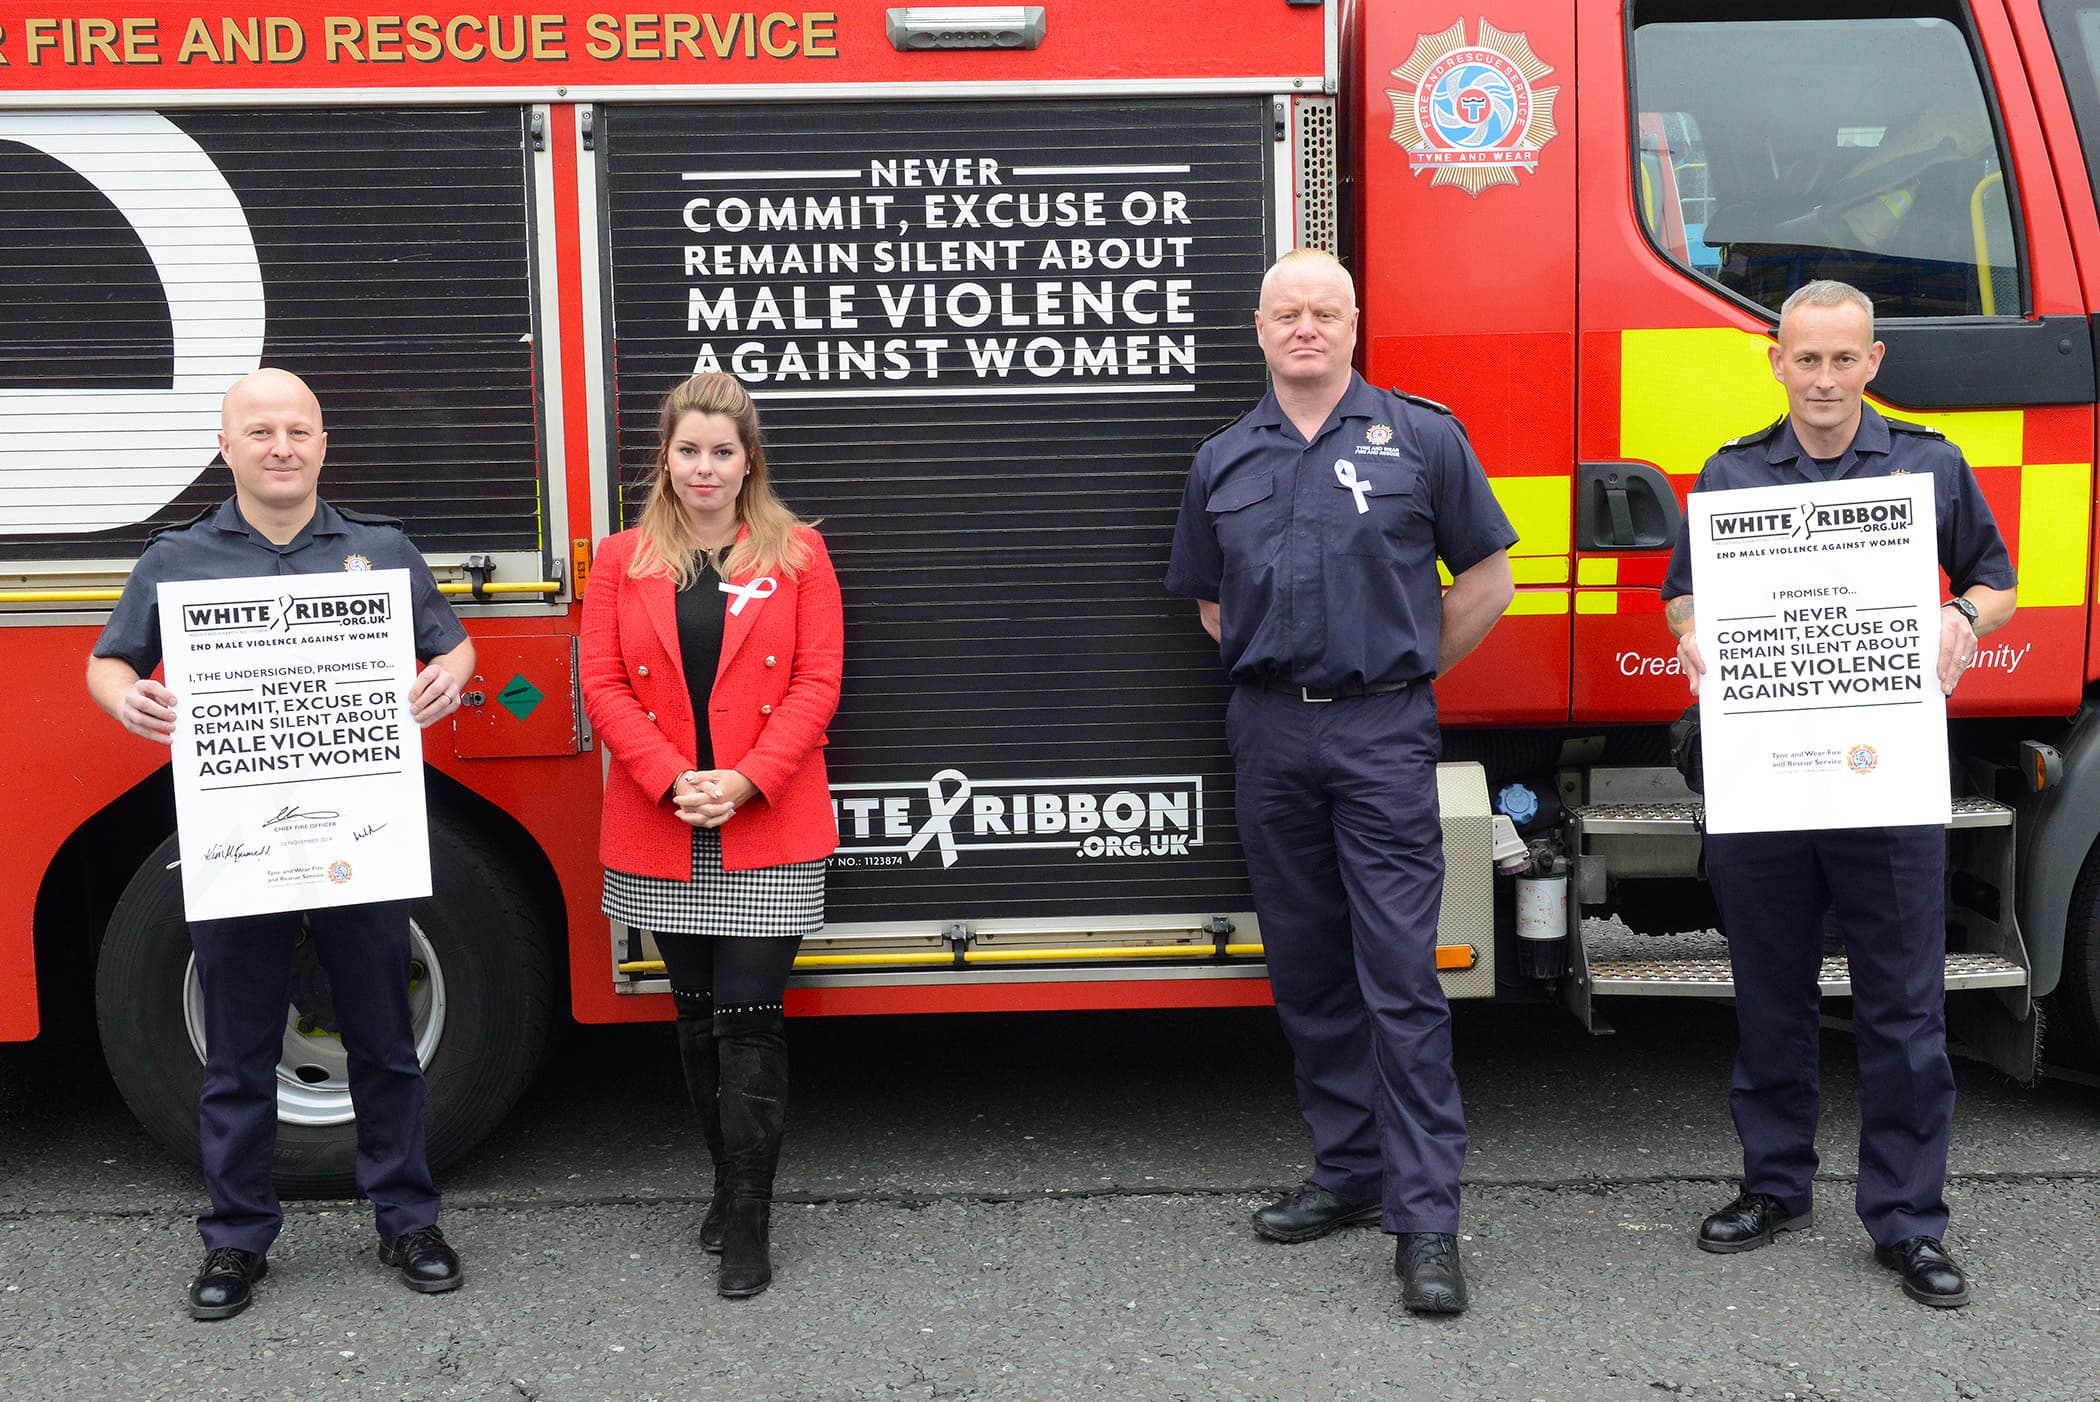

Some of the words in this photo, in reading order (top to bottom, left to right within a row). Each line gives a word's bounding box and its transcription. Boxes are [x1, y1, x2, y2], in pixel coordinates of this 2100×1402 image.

[25, 18, 161, 66] FIRE
[177, 17, 304, 63] AND
[324, 15, 567, 63] RESCUE
[585, 12, 839, 60] SERVICE
[1420, 95, 1431, 129] FIRE
[1426, 66, 1445, 93] AND
[1446, 52, 1503, 69] RESCUE
[1504, 66, 1528, 126] SERVICE
[1417, 153, 1452, 162] TYNE
[1459, 152, 1487, 161] AND
[1493, 151, 1532, 161] WEAR
[870, 158, 1002, 187] NEVER
[682, 194, 908, 236] COMMIT,
[925, 190, 1106, 229] EXCUSE
[1121, 189, 1192, 225] OR
[684, 242, 858, 276] REMAIN
[873, 239, 1024, 273] SILENT
[1038, 236, 1192, 270] ABOUT
[687, 285, 858, 332] MALE
[876, 278, 1195, 328] VIOLENCE
[693, 338, 949, 383] AGAINST
[965, 334, 1196, 378] WOMEN
[1716, 513, 1793, 535] WHITE
[1817, 503, 1907, 527] RIBBON
[1860, 521, 1907, 533] .ORG.UK
[1717, 551, 1736, 560] END
[1739, 549, 1765, 558] MALE
[1769, 545, 1818, 555] VIOLENCE
[1821, 541, 1866, 551] AGAINST
[1869, 537, 1910, 547] WOMEN
[1773, 591, 1776, 600] I
[1779, 587, 1830, 599] PROMISE
[1831, 586, 1857, 595] TO...
[189, 605, 270, 627] WHITE
[296, 598, 386, 621] RIBBON
[340, 615, 386, 627] .ORG.UK
[1783, 606, 1848, 623] NEVER
[190, 643, 211, 651] END
[215, 641, 243, 650] MALE
[246, 637, 297, 648] VIOLENCE
[301, 634, 345, 644] AGAINST
[348, 631, 388, 641] WOMEN
[1717, 626, 1800, 645] COMMIT,
[1804, 620, 1883, 639] EXCUSE
[1889, 618, 1918, 633] OR
[1719, 645, 1785, 660] REMAIN
[1790, 640, 1852, 656] SILENT
[1855, 635, 1920, 652] ABOUT
[196, 672, 221, 682] THE
[224, 665, 315, 680] UNDERSIGNED,
[317, 661, 368, 673] PROMISE
[369, 660, 395, 669] TO...
[1616, 652, 1687, 676] 'Crea
[1720, 661, 1787, 681] MALE
[1790, 652, 1921, 677] VIOLENCE
[261, 679, 327, 697] NEVER
[1723, 680, 1824, 701] AGAINST
[1828, 674, 1922, 695] WOMEN
[191, 700, 279, 719] COMMIT,
[283, 693, 363, 712] EXCUSE
[368, 691, 397, 705] OR
[194, 718, 264, 735] REMAIN
[269, 713, 332, 729] SILENT
[335, 707, 398, 724] ABOUT
[196, 735, 267, 757] MALE
[270, 724, 399, 750] VIOLENCE
[199, 753, 305, 777] AGAINST
[308, 745, 401, 767] WOMEN
[973, 791, 1189, 836] RIBBON
[1076, 835, 1189, 858] .ORG.UK
[838, 858, 862, 866] NO.:
[864, 856, 902, 865] 1123874
